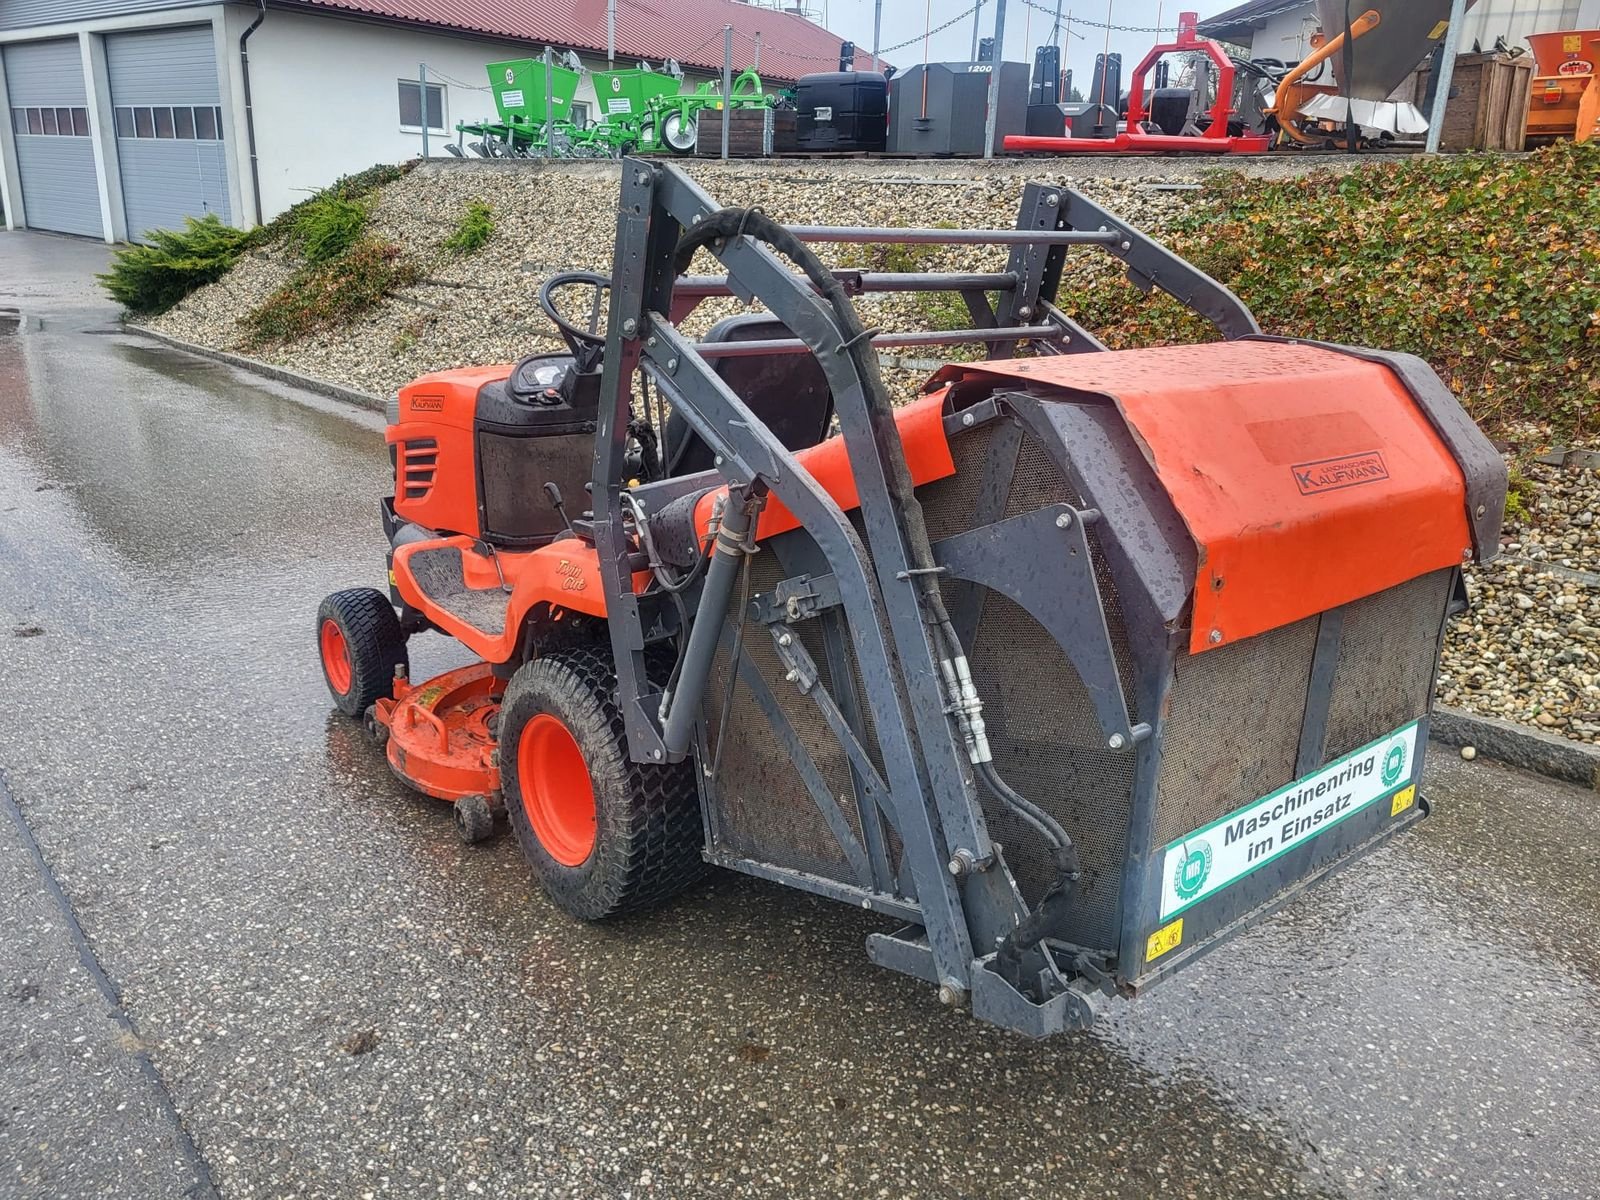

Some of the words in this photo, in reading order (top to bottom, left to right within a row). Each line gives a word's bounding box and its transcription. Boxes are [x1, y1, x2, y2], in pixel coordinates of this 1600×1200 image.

[967, 65, 993, 73] 1200
[1296, 464, 1385, 489] KAUFMANN
[1320, 458, 1378, 474] LANDMASCHINEN
[555, 559, 583, 579] Twin
[562, 576, 587, 591] Cut
[1224, 755, 1375, 846] Maschinenring
[1247, 836, 1274, 862] im
[1280, 793, 1352, 844] Einsatz
[1185, 859, 1201, 881] MR
